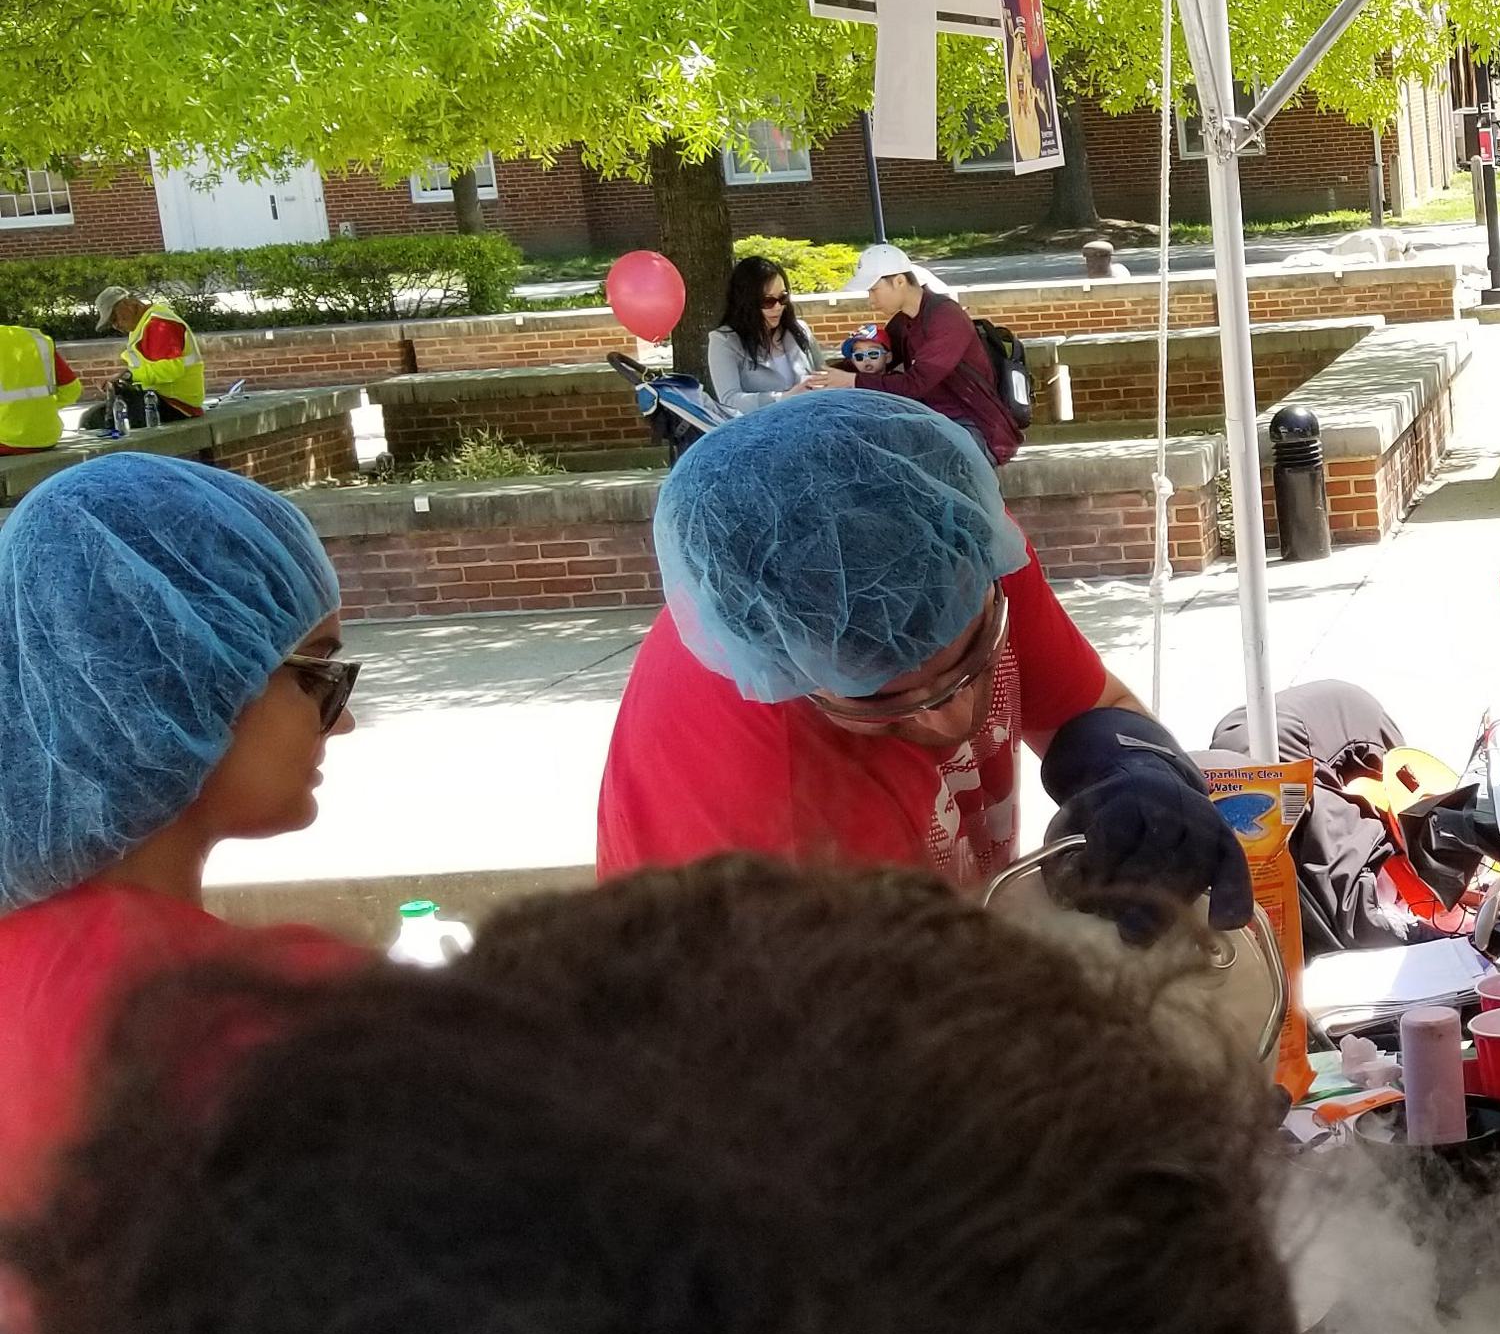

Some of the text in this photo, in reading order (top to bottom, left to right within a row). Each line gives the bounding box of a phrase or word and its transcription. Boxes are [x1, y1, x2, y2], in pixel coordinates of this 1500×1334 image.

[1203, 769, 1284, 781] Sparkling Clear
[1210, 782, 1243, 793] Water
